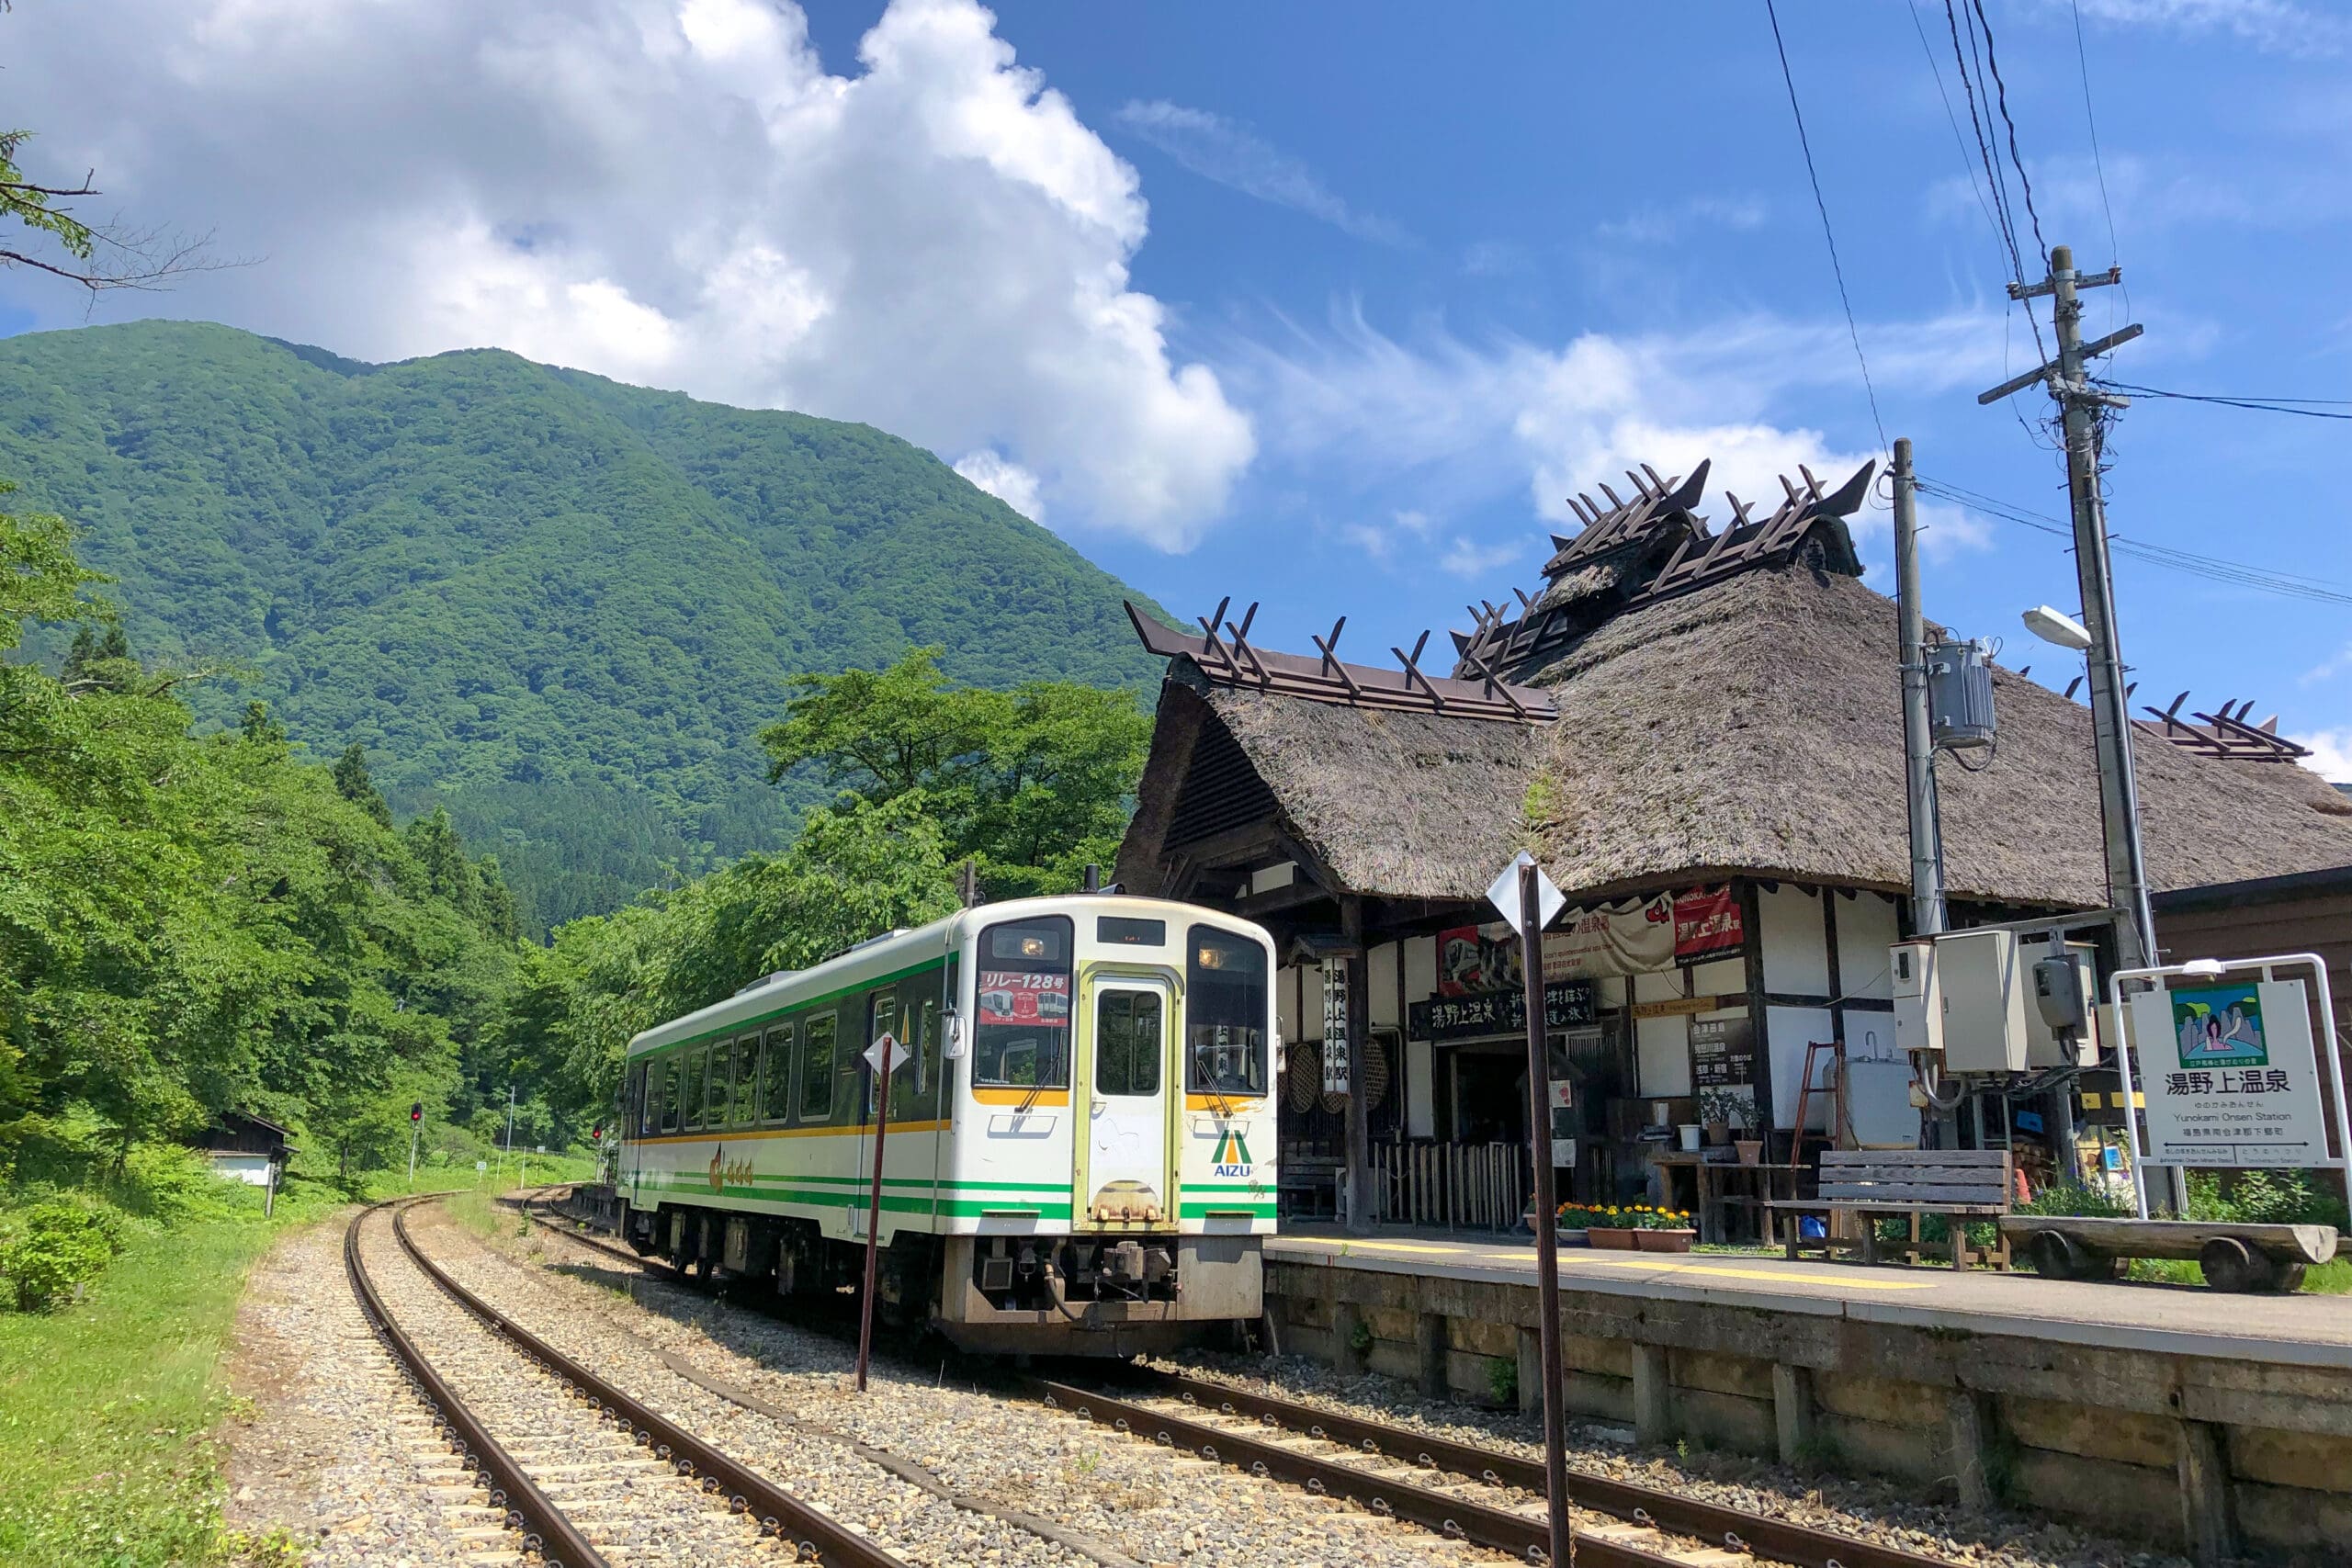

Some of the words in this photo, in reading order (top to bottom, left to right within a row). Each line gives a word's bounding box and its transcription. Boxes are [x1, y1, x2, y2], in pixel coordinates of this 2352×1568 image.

[987, 974, 1064, 989] リレー128号
[1432, 998, 1496, 1028] 湯野上温泉
[1334, 969, 1347, 1080] 湯野上温泉駅
[2165, 1068, 2290, 1095] 湯野上温泉
[2174, 1113, 2219, 1122] Yunokami
[2222, 1112, 2253, 1122] Onsen
[2256, 1111, 2291, 1121] Station
[2183, 1127, 2283, 1137] 福島県南会津郡下郷町
[1214, 1165, 1250, 1177] AIZU
